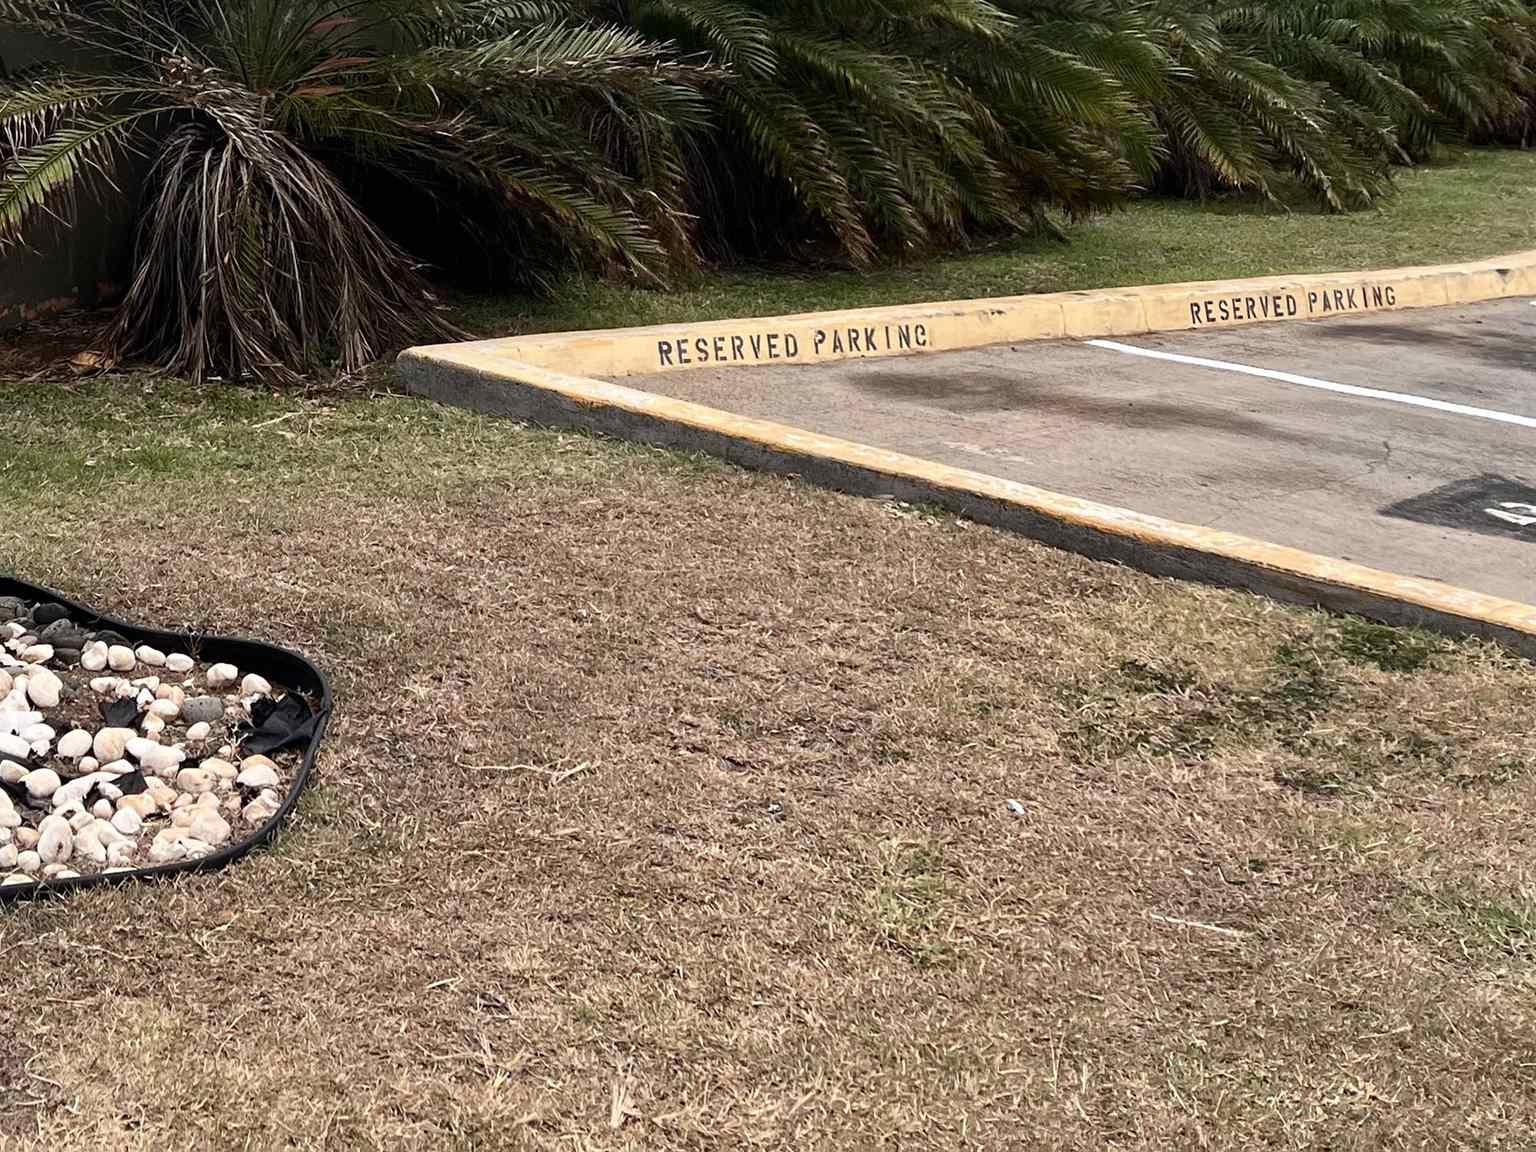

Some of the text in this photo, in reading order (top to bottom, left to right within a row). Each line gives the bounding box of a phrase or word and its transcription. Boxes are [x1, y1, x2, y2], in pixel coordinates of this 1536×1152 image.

[1190, 286, 1396, 324] RESERVED PARKING
[658, 333, 799, 366] RESERVED
